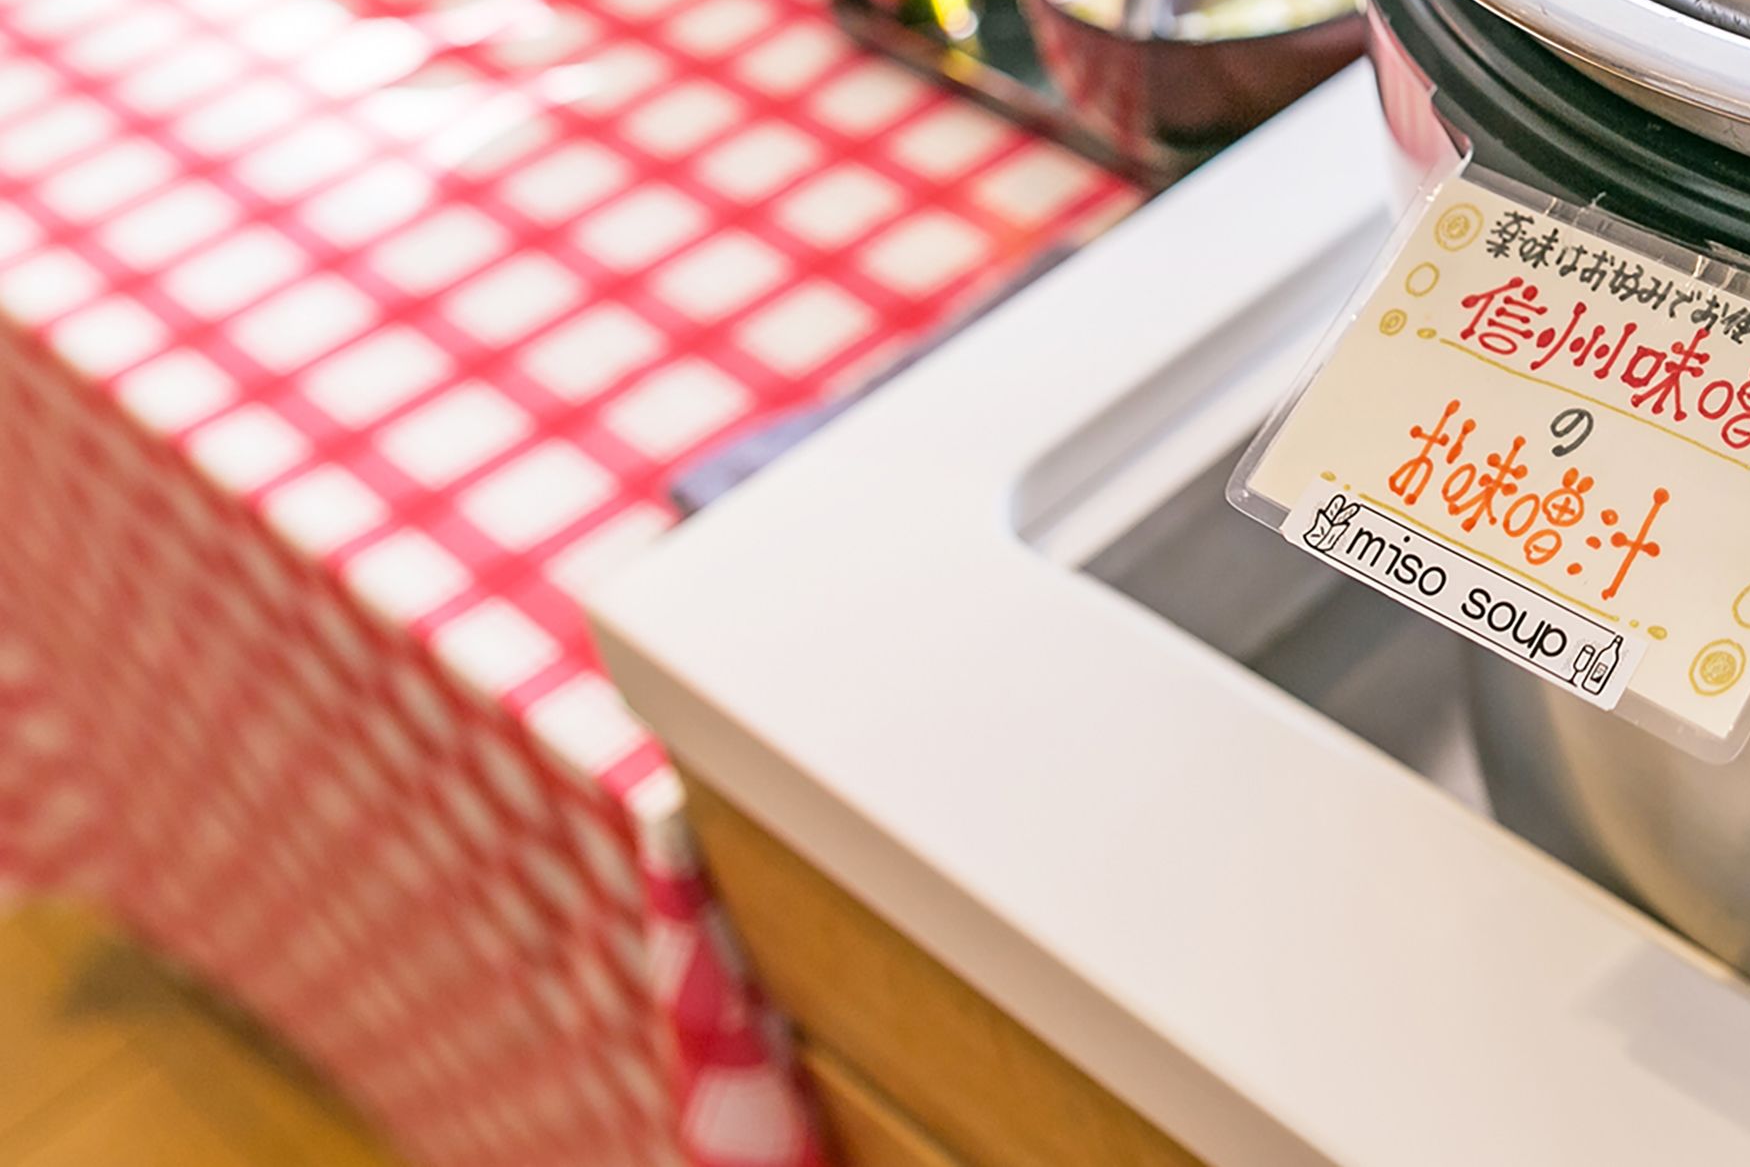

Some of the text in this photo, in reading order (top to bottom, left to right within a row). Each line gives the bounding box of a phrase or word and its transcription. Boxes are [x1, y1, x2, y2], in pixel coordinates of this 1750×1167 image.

[1549, 407, 1595, 458] の
[1388, 399, 1671, 601] お味噌汁
[1345, 526, 1568, 659] miso soup
